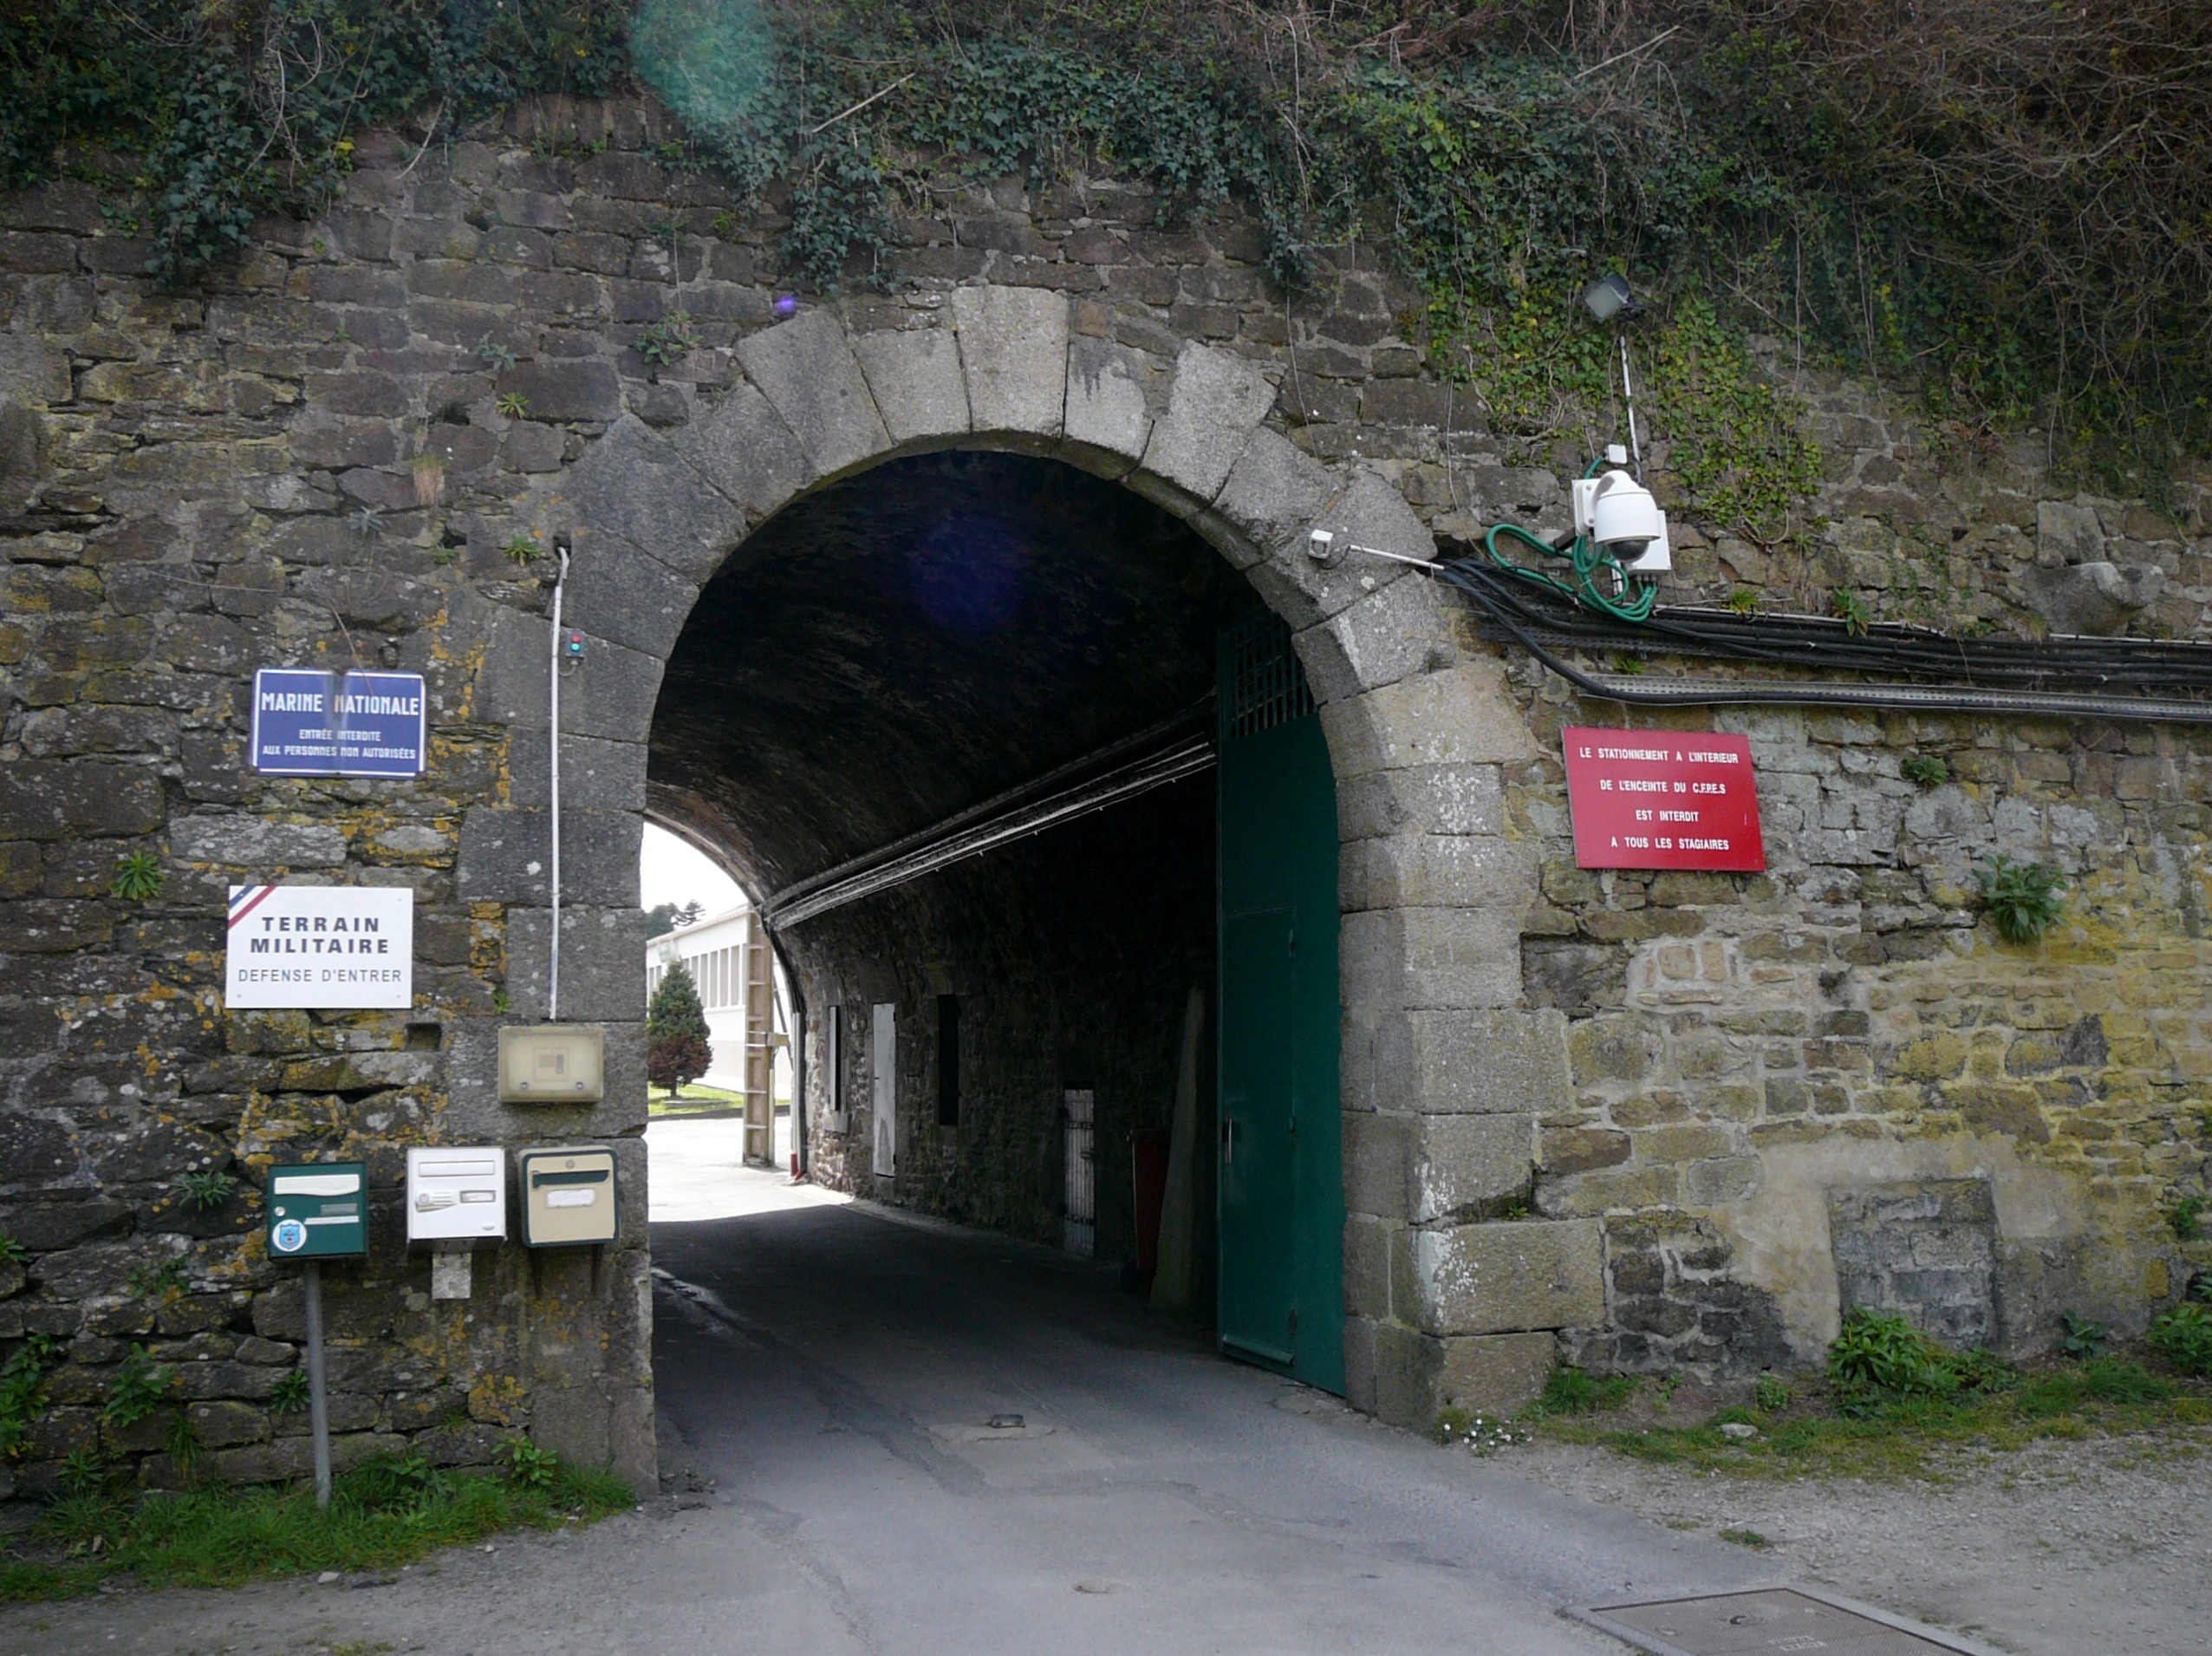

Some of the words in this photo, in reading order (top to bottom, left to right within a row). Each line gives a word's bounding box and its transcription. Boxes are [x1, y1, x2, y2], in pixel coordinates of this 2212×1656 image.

[261, 693, 323, 712] MARINE
[334, 694, 420, 715] NATIONALE
[299, 728, 333, 740] ENTRÉE
[337, 730, 381, 741] INTERDITE
[263, 746, 281, 755] AUX
[284, 746, 337, 756] PERSONNES
[341, 747, 359, 757] NON
[362, 747, 415, 759] AUTORISÉES
[1579, 747, 1591, 758] LE
[1598, 748, 1669, 761] STATIONNEMENT
[1676, 751, 1682, 761] A
[1688, 752, 1739, 763] L'INTERIEUR
[1600, 780, 1612, 790] DE
[1619, 780, 1668, 792] L'ENCEINTE
[1674, 783, 1686, 793] DU
[1636, 810, 1652, 820] EST
[1660, 811, 1699, 822] INTERDIT
[1611, 837, 1617, 847] A
[1624, 838, 1649, 848] TOUS
[1655, 838, 1672, 849] LES
[1679, 838, 1729, 851] STAGIAIRES
[262, 917, 379, 932] TERRAIN
[250, 938, 388, 954] MILITAIRE
[238, 969, 312, 981] DEFENSE
[322, 969, 402, 982] D'ENTRER
